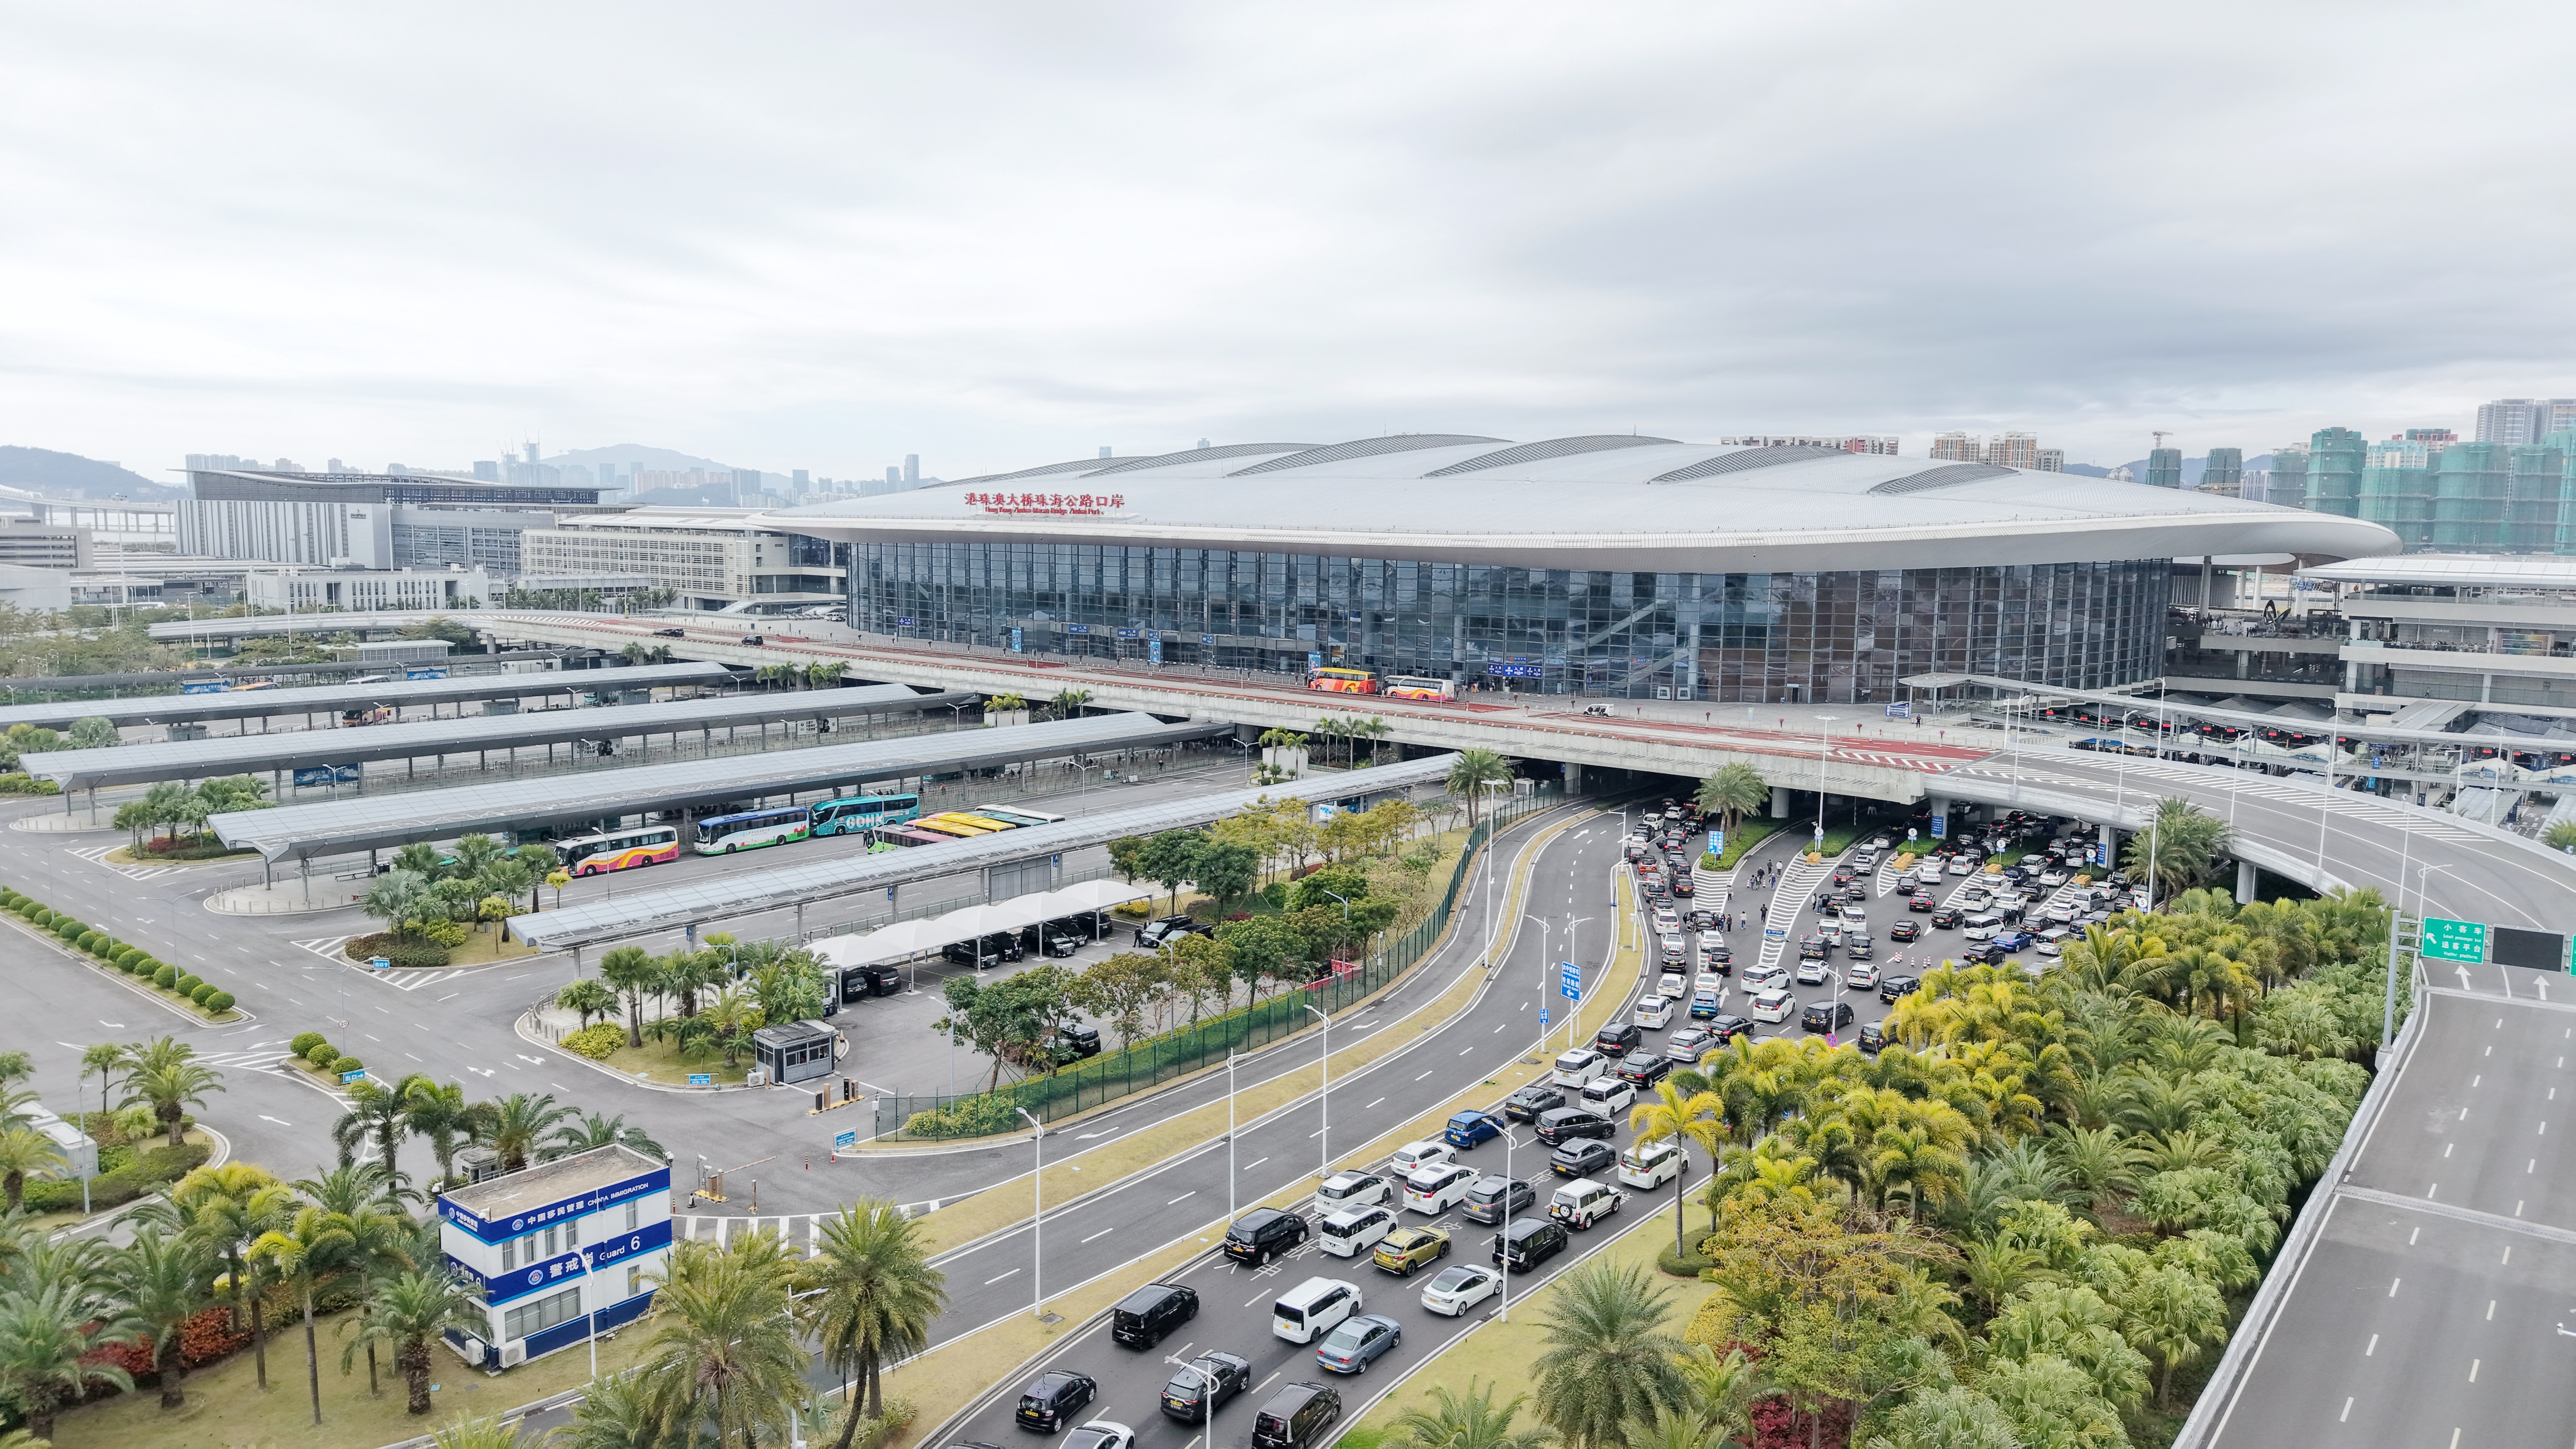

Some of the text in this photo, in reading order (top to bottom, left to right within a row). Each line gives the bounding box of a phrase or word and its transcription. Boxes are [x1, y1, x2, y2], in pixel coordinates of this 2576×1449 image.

[964, 493, 1124, 508] 港珠澳大桥珠海公路口岸
[2444, 923, 2482, 935] 小客车
[2442, 941, 2481, 953] 送客平台
[527, 1182, 649, 1225] 中国移民管理 CHINA IMMIGRATION
[600, 1245, 625, 1261] Guard
[631, 1236, 641, 1250] 6
